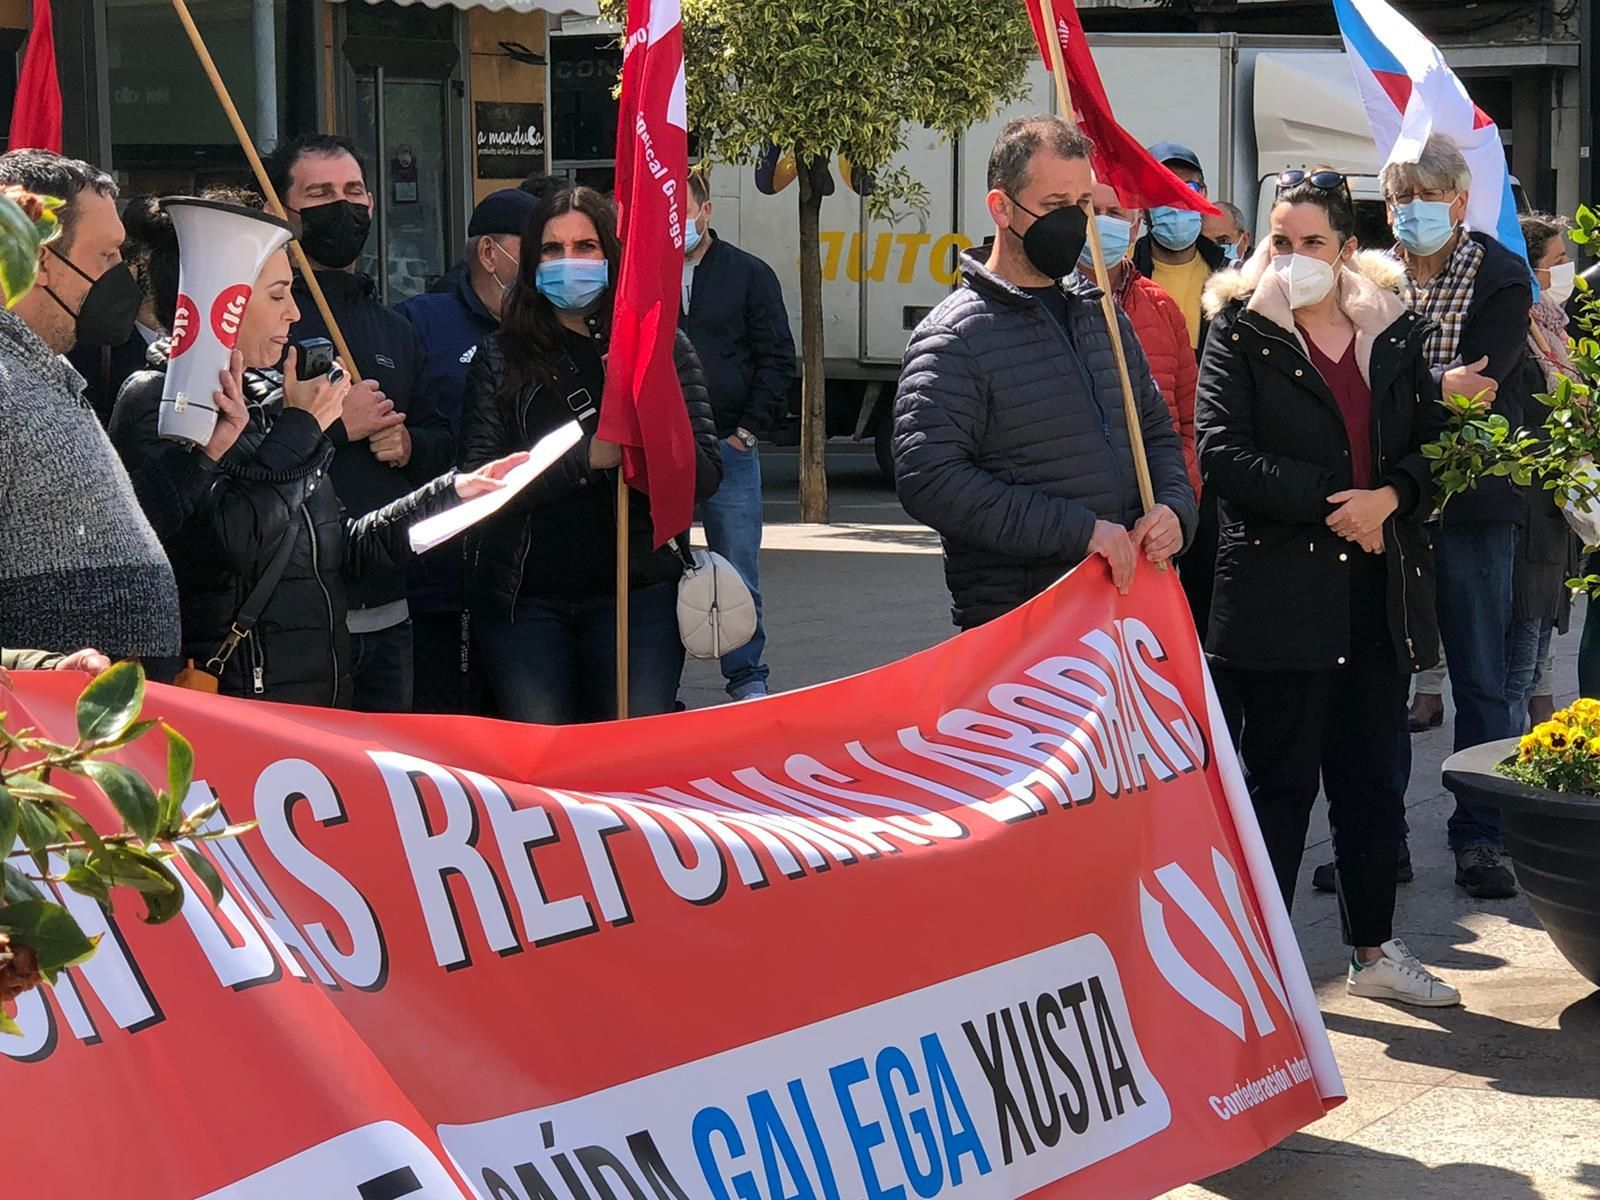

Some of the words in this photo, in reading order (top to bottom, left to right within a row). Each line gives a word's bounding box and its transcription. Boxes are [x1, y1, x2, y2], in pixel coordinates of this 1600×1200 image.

[143, 758, 389, 993] DAS
[364, 749, 969, 972] REFORMAS
[844, 617, 1210, 825] LABORAIS
[960, 975, 1146, 1166] XUSTA
[1208, 1064, 1294, 1121] Confederación
